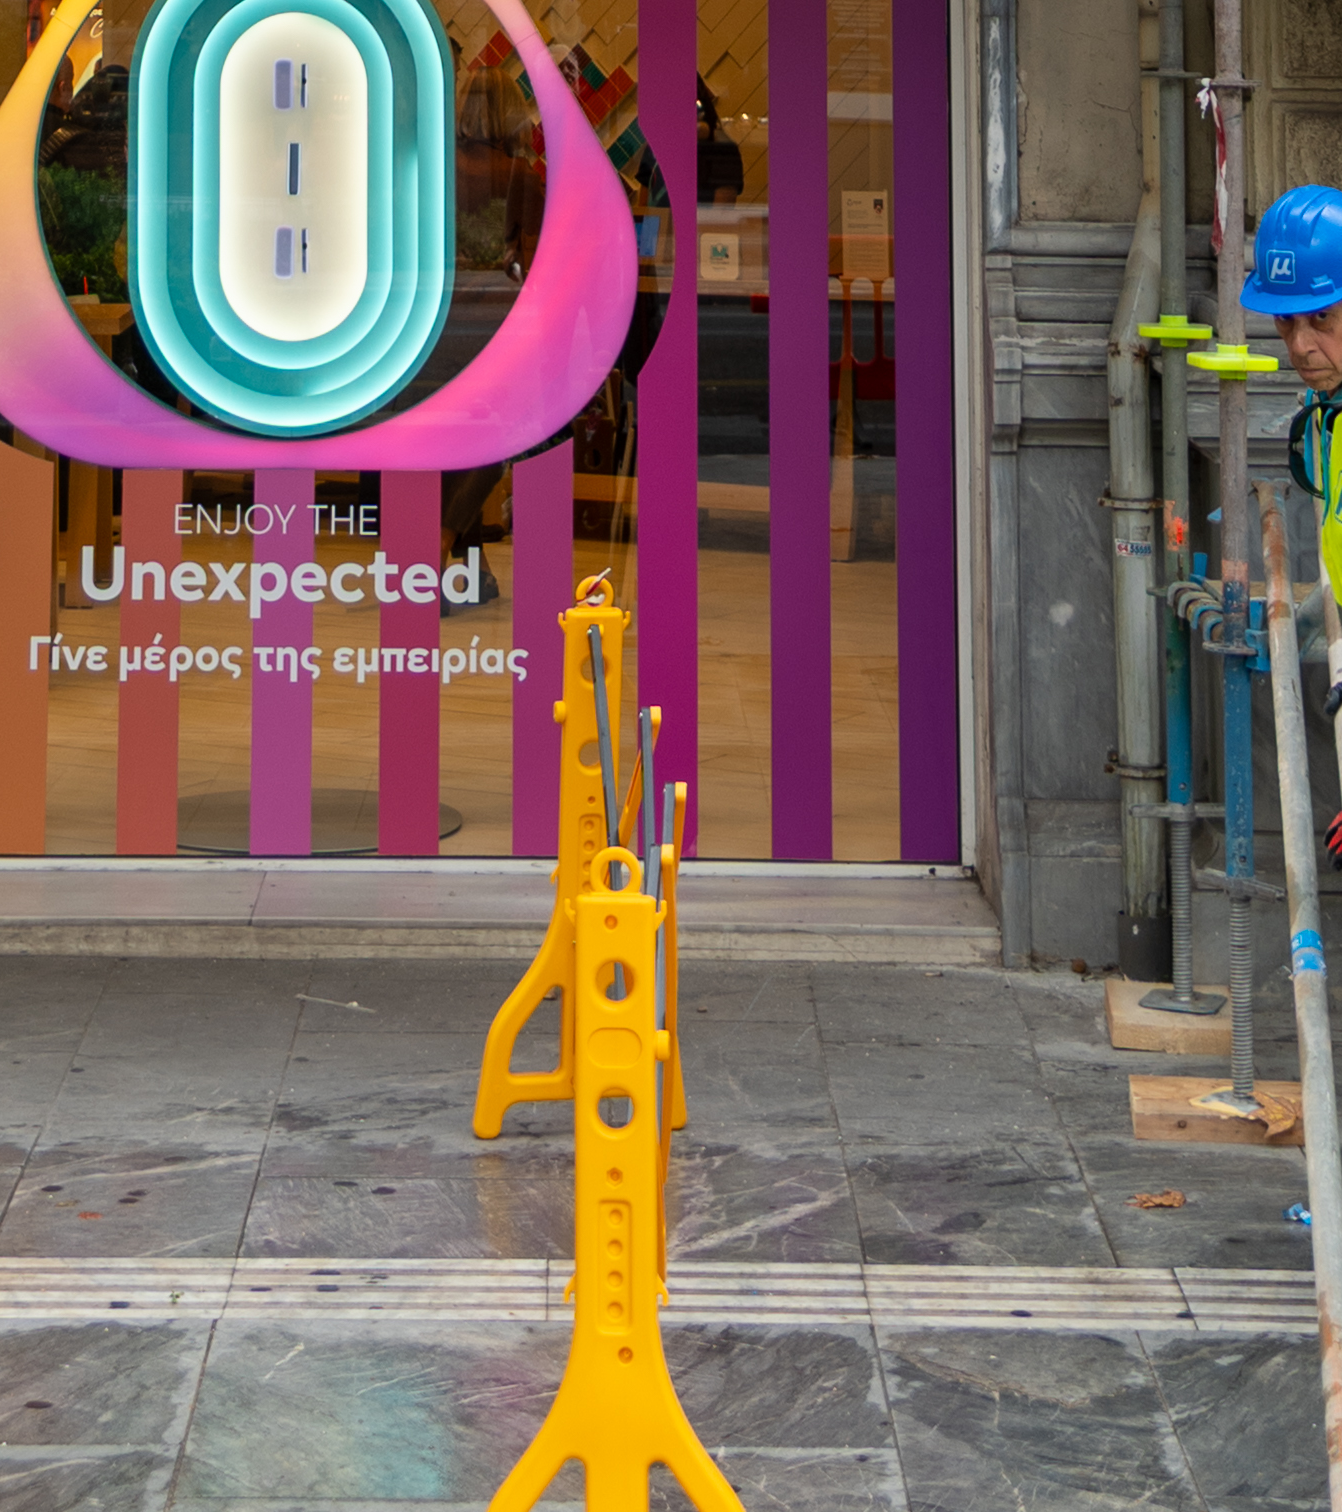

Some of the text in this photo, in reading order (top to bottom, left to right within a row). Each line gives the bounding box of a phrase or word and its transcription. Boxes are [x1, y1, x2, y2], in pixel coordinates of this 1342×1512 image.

[174, 504, 379, 536] ENJOY THE
[80, 545, 481, 619] Unexpected
[29, 632, 530, 684] Γίνε μέρος της εμπειρίας
